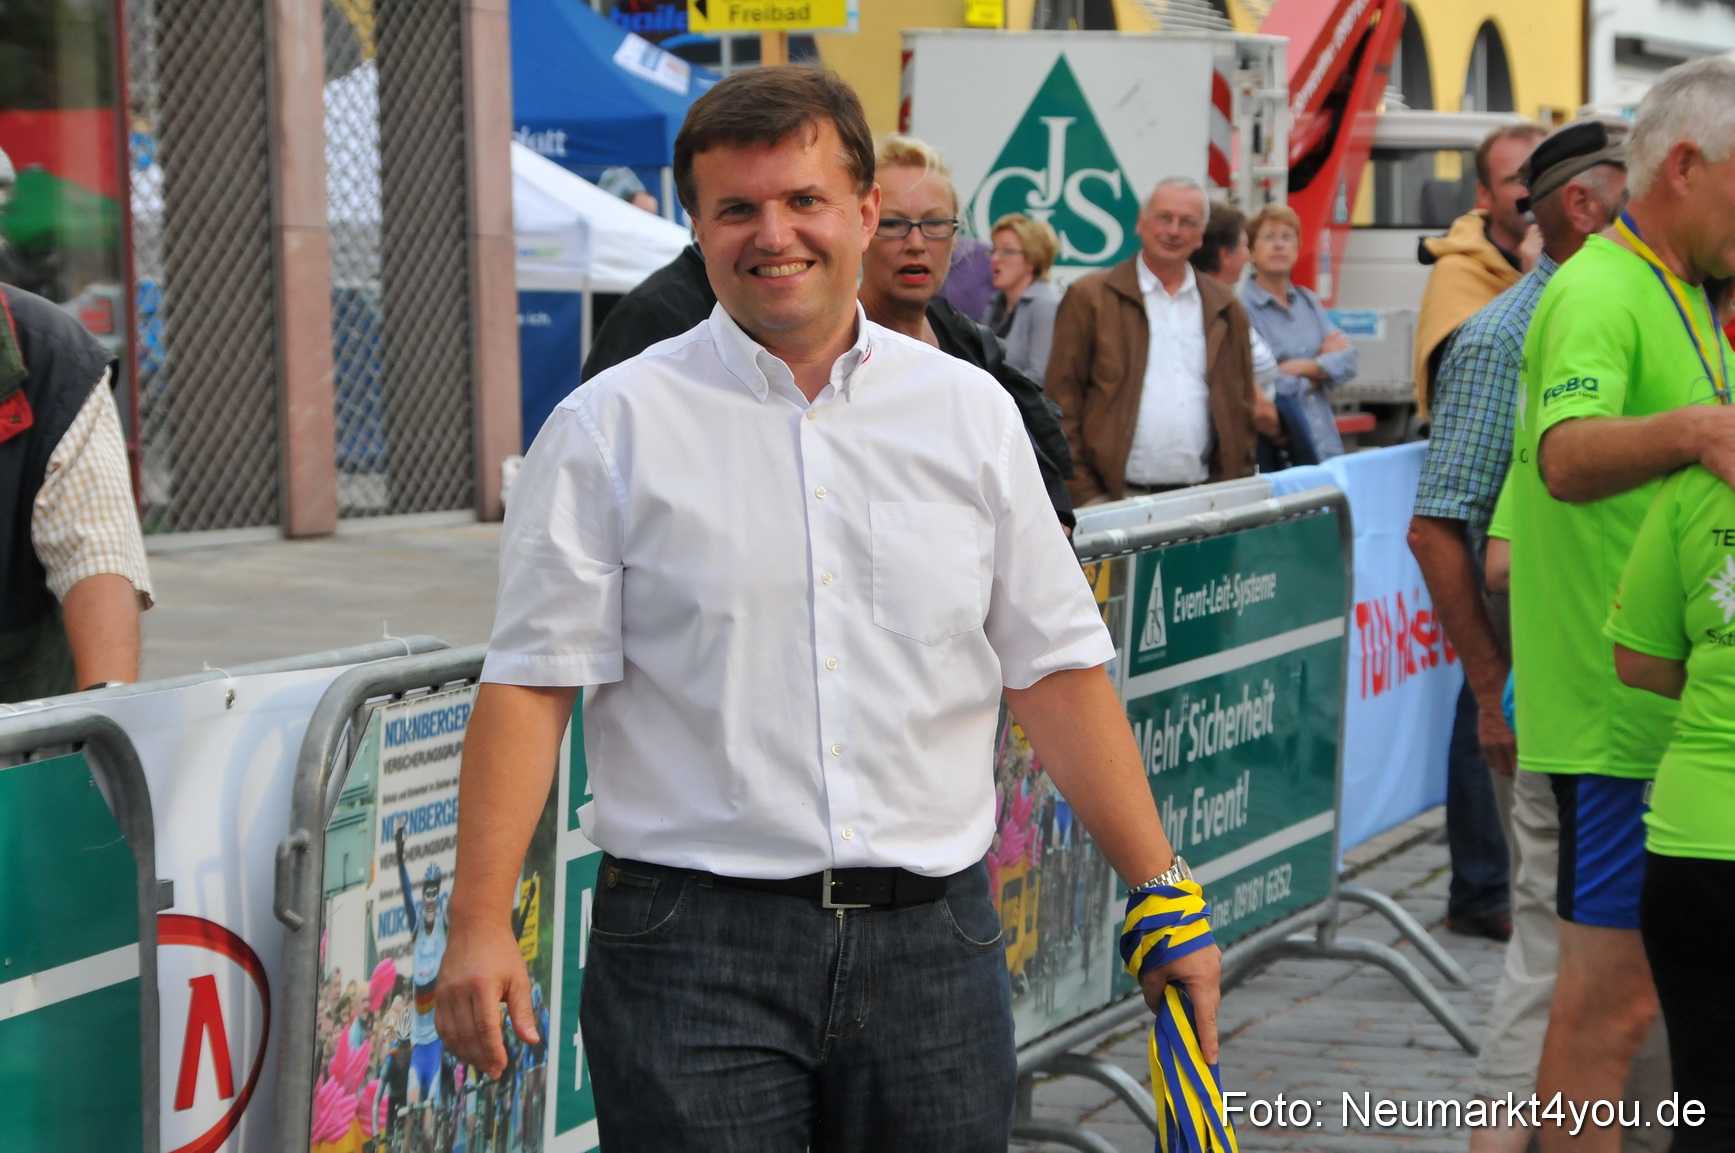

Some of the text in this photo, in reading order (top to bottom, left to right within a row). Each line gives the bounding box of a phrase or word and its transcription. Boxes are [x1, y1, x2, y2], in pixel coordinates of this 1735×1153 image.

[728, 4, 811, 23] Freibad
[1173, 572, 1277, 624] Event-Leit-Systeme
[1134, 678, 1275, 777] Mehr Sicherheit
[1161, 769, 1250, 852] Ihr Event!
[1265, 863, 1292, 905] 6352
